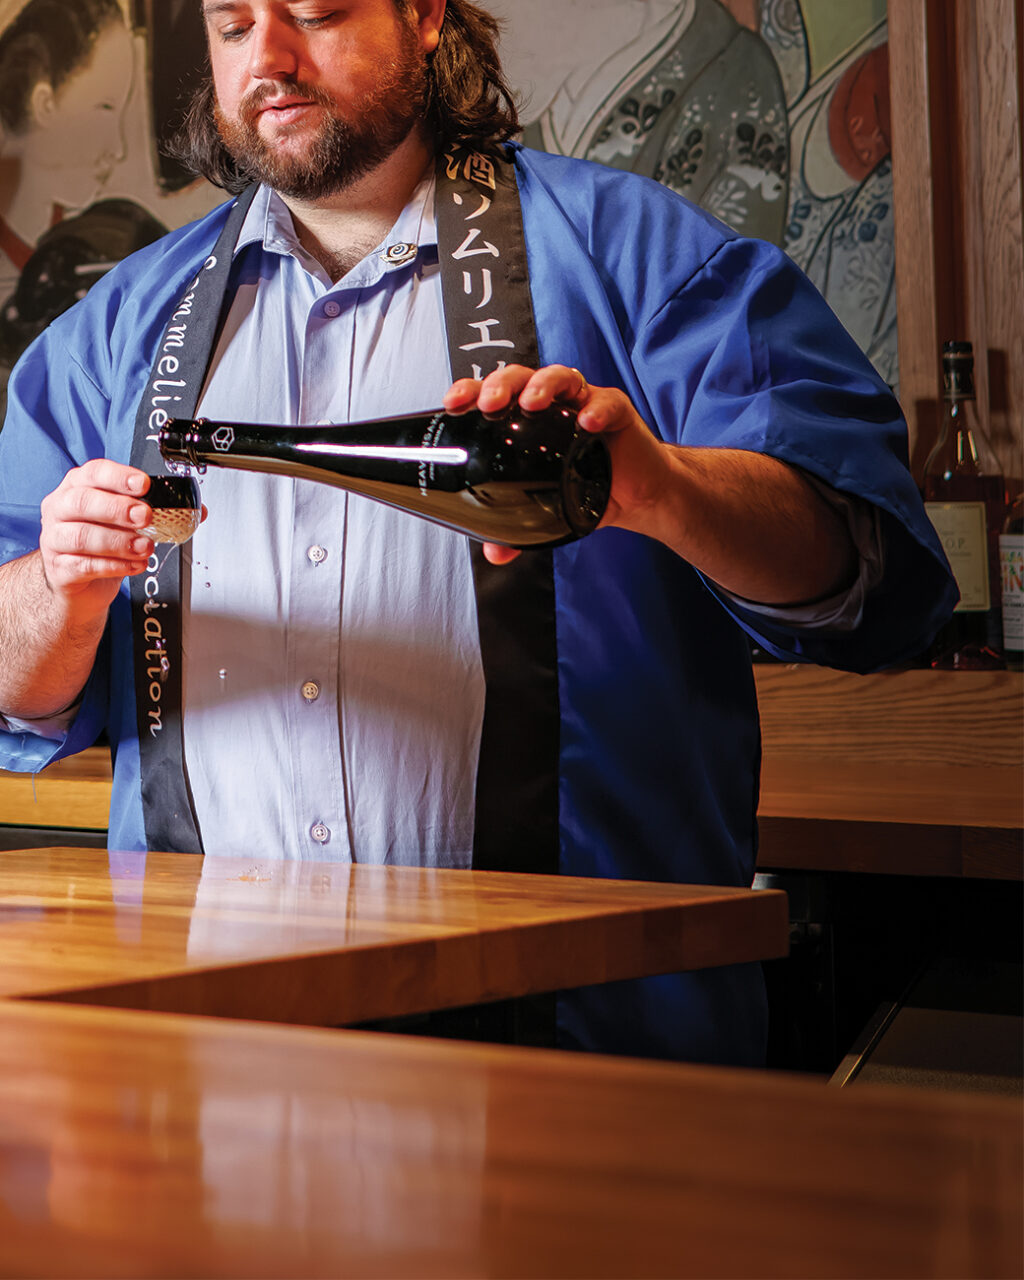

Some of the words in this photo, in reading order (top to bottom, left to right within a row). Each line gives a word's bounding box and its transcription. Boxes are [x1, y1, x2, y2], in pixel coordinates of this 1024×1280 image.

[445, 142, 516, 382] 酒ソムリエ
[418, 412, 446, 497] HEAVNSAKE
[144, 542, 169, 738] ociation
